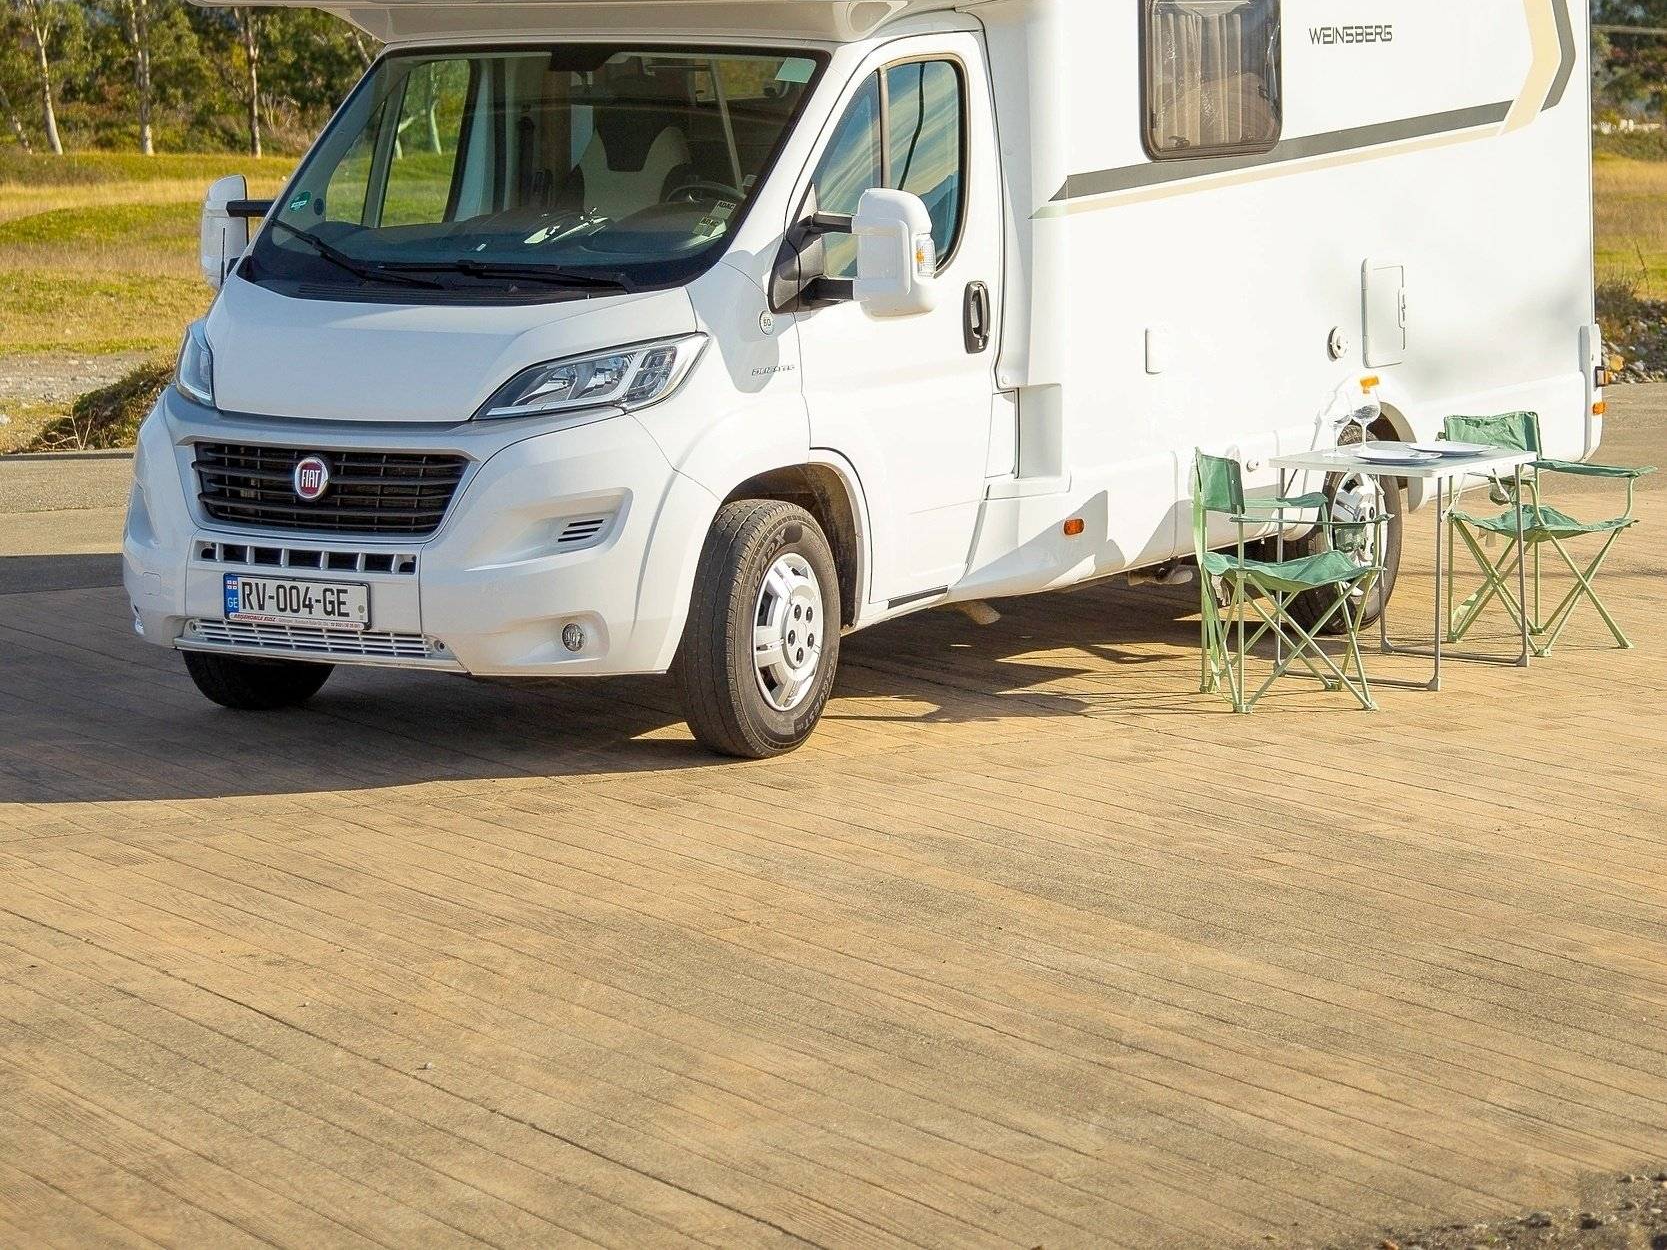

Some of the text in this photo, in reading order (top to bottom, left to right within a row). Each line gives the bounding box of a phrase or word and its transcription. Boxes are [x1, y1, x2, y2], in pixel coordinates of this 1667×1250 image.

[1308, 25, 1393, 45] WEINSBERG
[301, 469, 321, 488] FIAT
[227, 597, 239, 609] GE
[241, 581, 350, 618] RV-004-GE
